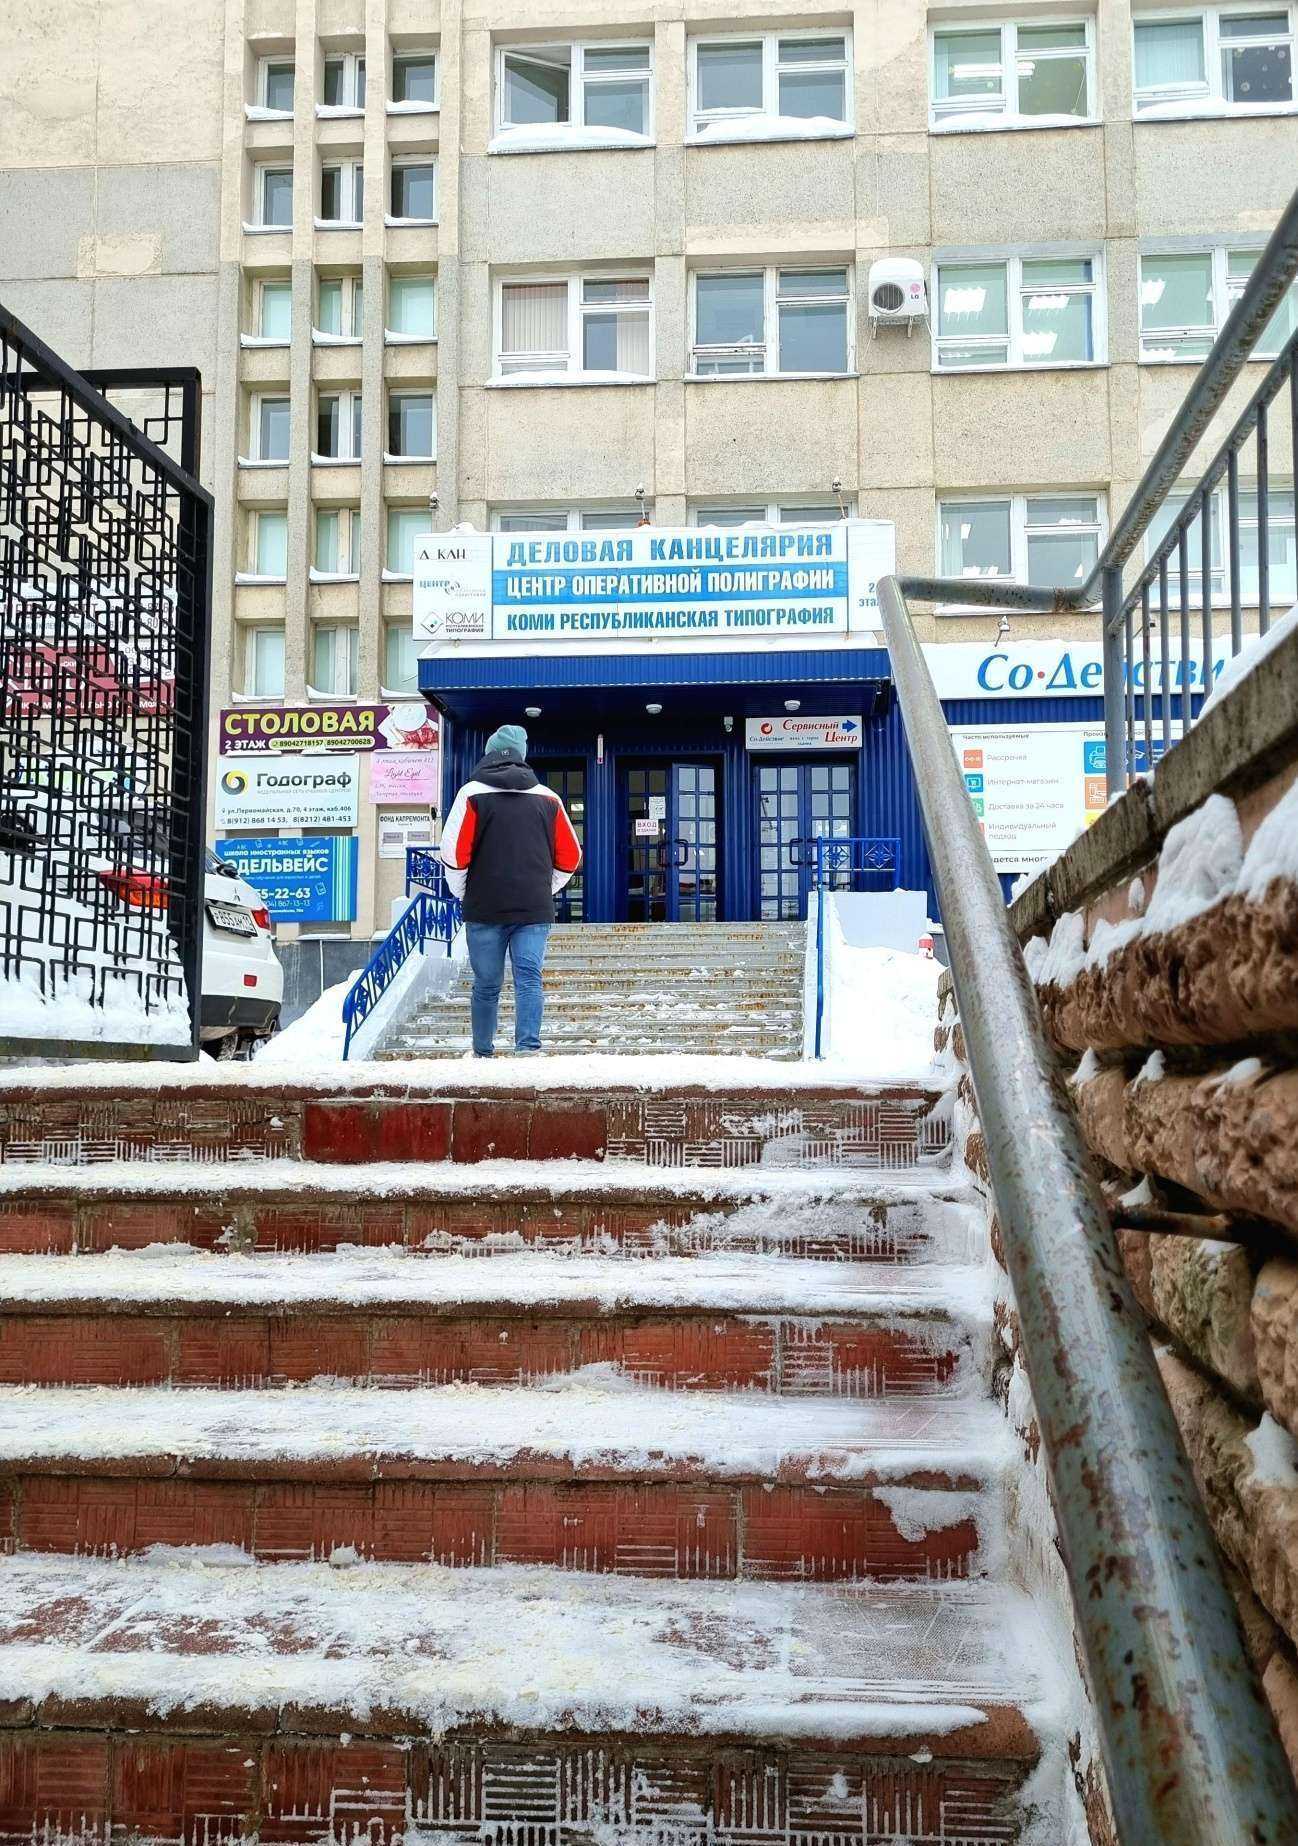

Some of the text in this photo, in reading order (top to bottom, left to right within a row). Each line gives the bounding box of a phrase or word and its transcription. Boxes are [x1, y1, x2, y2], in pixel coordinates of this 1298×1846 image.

[507, 534, 832, 566] ДЕЛОВАЯ КАНЦЕЛЯРИЯ
[507, 568, 834, 599] ЦЕНТР ОПЕРАТИВНОЙ ПОЛИГРАФИИ
[868, 582, 876, 593] 2
[445, 612, 485, 624] КОМИ
[507, 607, 834, 631] КОМИ РЕСПУБЛИКАНСКАЯ ТИПОГРАФИЯ
[225, 711, 375, 735] СТОЛОВАЯ
[782, 719, 839, 732] Сервисный
[825, 731, 858, 744] Центр
[225, 740, 232, 750] 2
[234, 740, 266, 749] ЭТАЖ
[257, 771, 352, 789] Годограф
[380, 815, 395, 823] ФОНД
[224, 849, 249, 857] школа
[250, 849, 301, 857] иностранных
